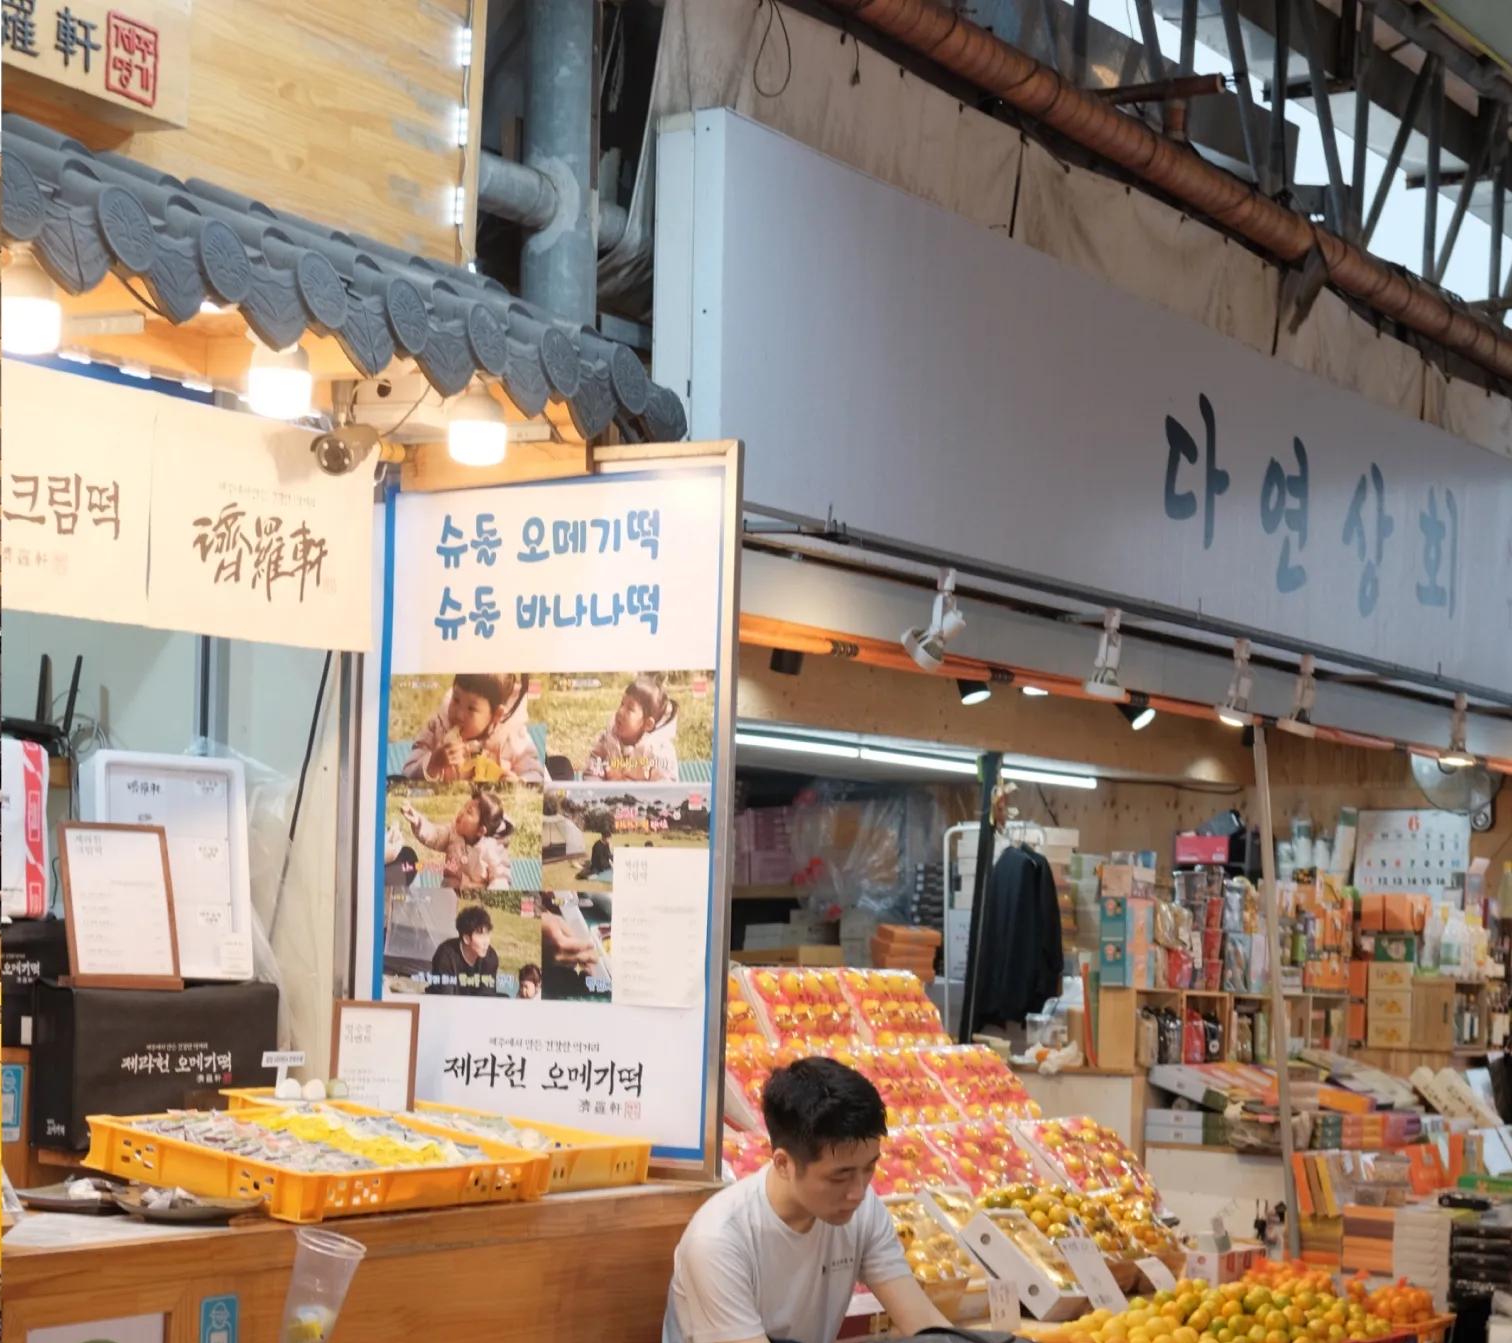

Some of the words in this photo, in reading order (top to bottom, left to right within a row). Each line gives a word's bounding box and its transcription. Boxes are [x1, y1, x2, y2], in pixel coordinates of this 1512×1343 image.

[2, 473, 120, 540] 크림떡
[1164, 392, 1459, 620] 다연상회
[436, 514, 503, 569] 슈돌
[517, 509, 660, 563] 오메기떡
[434, 586, 501, 641] 슈돌
[515, 584, 661, 635] 바나나떡
[1408, 814, 1420, 832] 6
[121, 1052, 170, 1075] 제라헌
[175, 1051, 232, 1073] 오메기떡
[444, 1052, 527, 1089] 제라헌
[541, 1059, 644, 1098] 오메기떡
